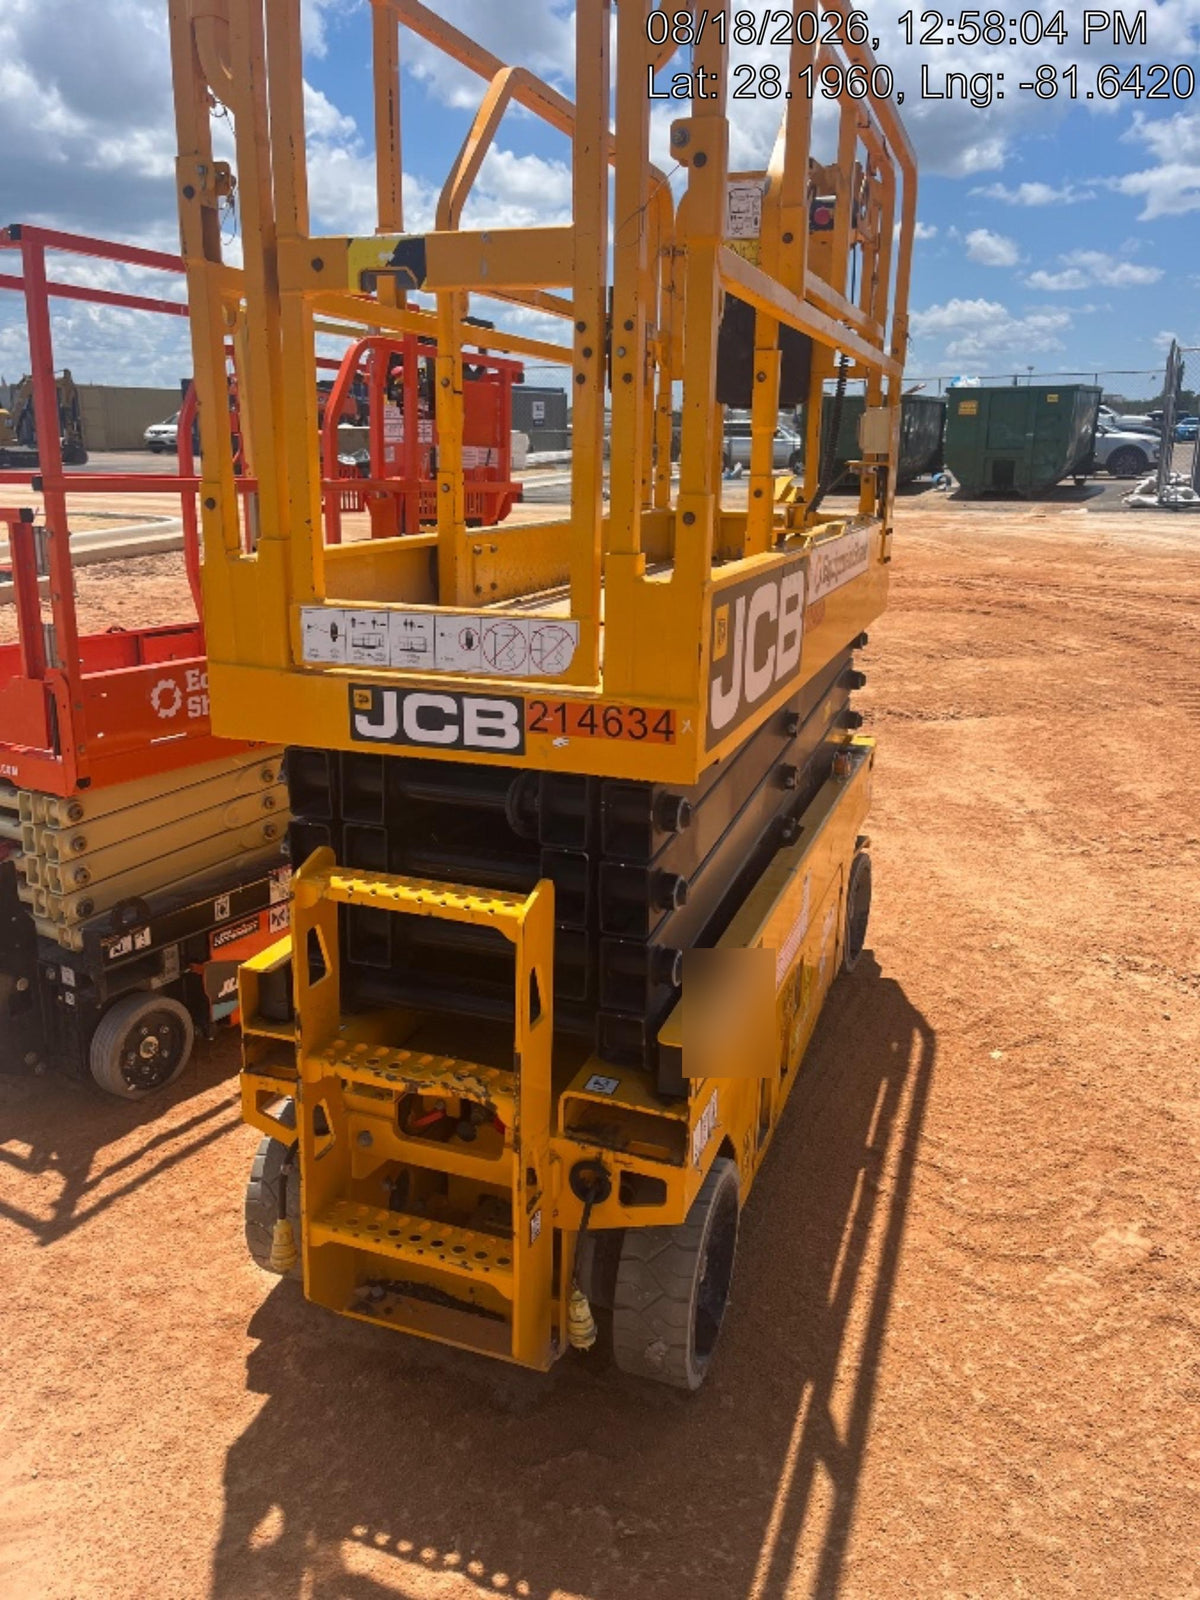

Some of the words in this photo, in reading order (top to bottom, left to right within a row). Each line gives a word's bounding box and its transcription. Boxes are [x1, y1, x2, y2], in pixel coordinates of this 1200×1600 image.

[711, 570, 805, 730] JCB
[355, 691, 520, 750] JCB
[528, 700, 674, 742] 214634
